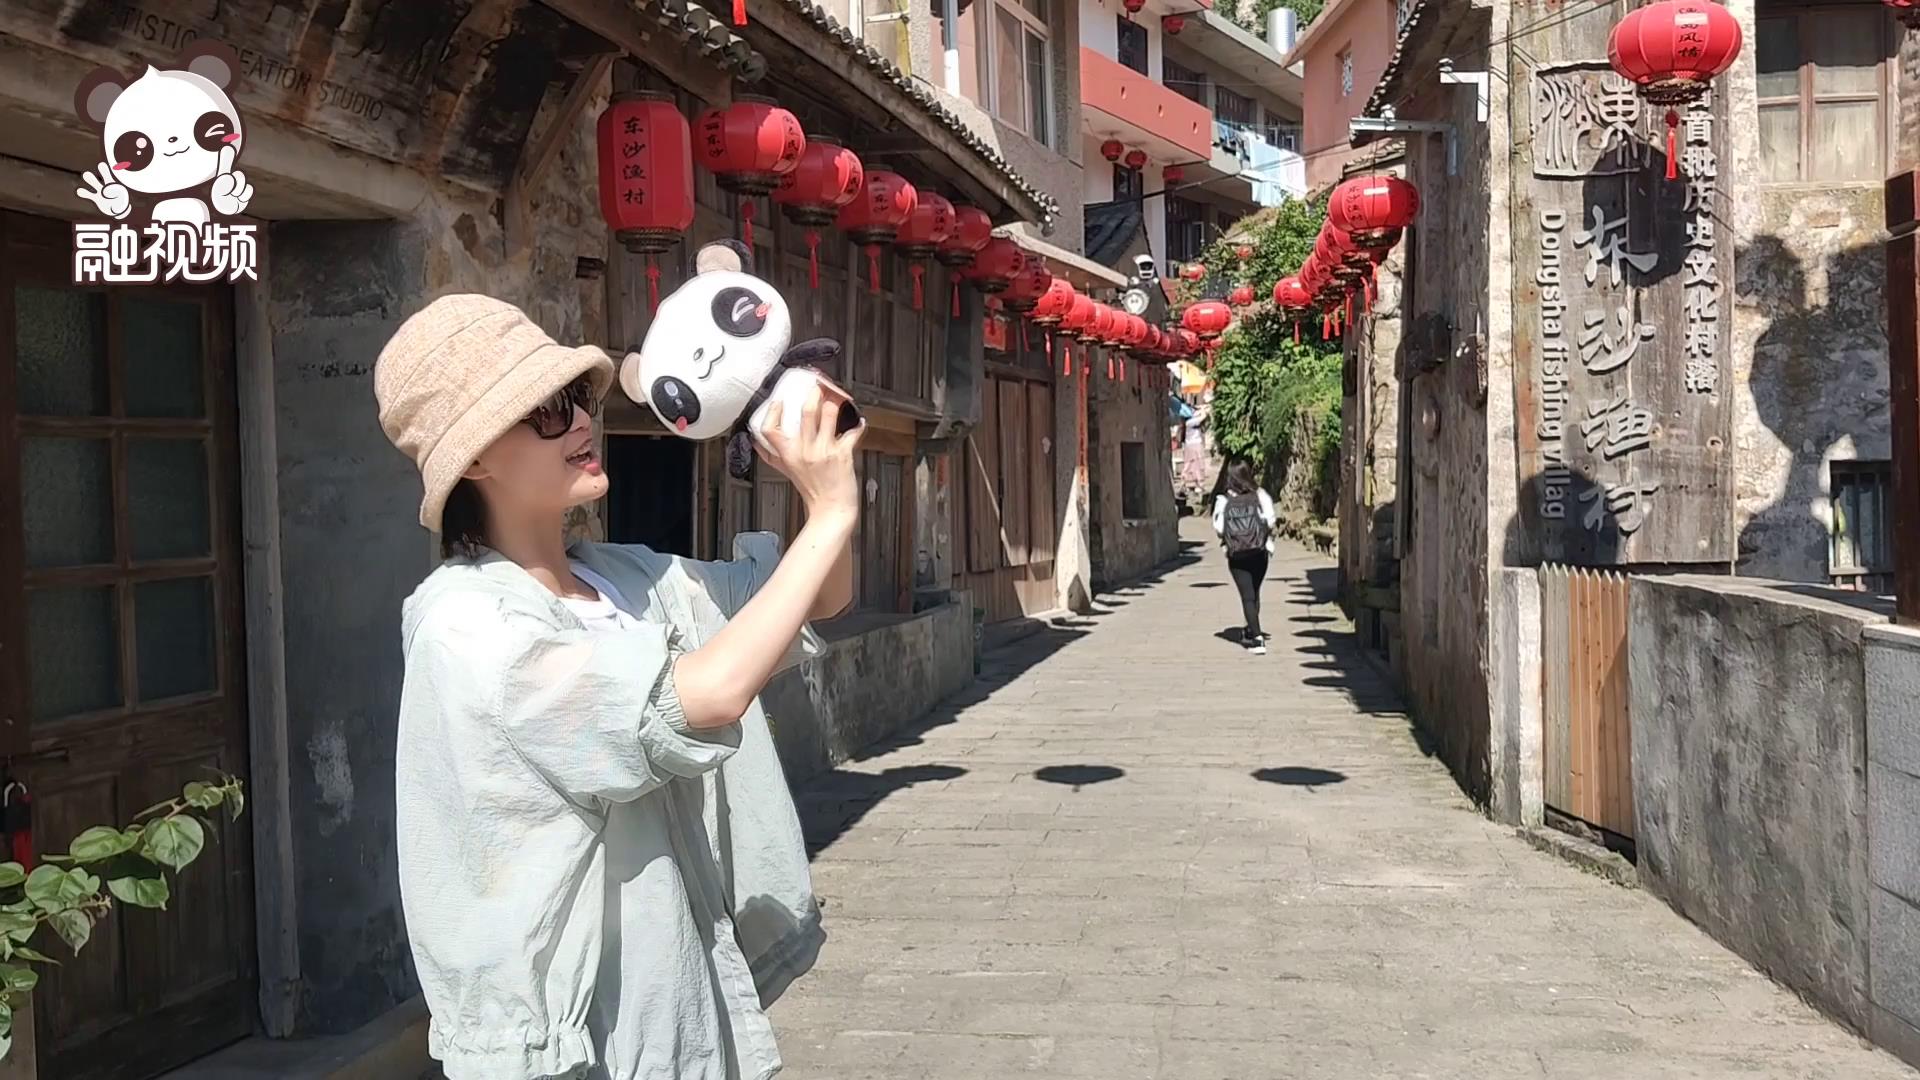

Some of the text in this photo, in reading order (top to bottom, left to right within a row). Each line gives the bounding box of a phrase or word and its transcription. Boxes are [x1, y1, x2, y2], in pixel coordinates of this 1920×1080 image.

[318, 79, 385, 122] STUDIO
[622, 115, 647, 205] 东沙渔村
[1535, 209, 1571, 519] Dongsha fishing villag
